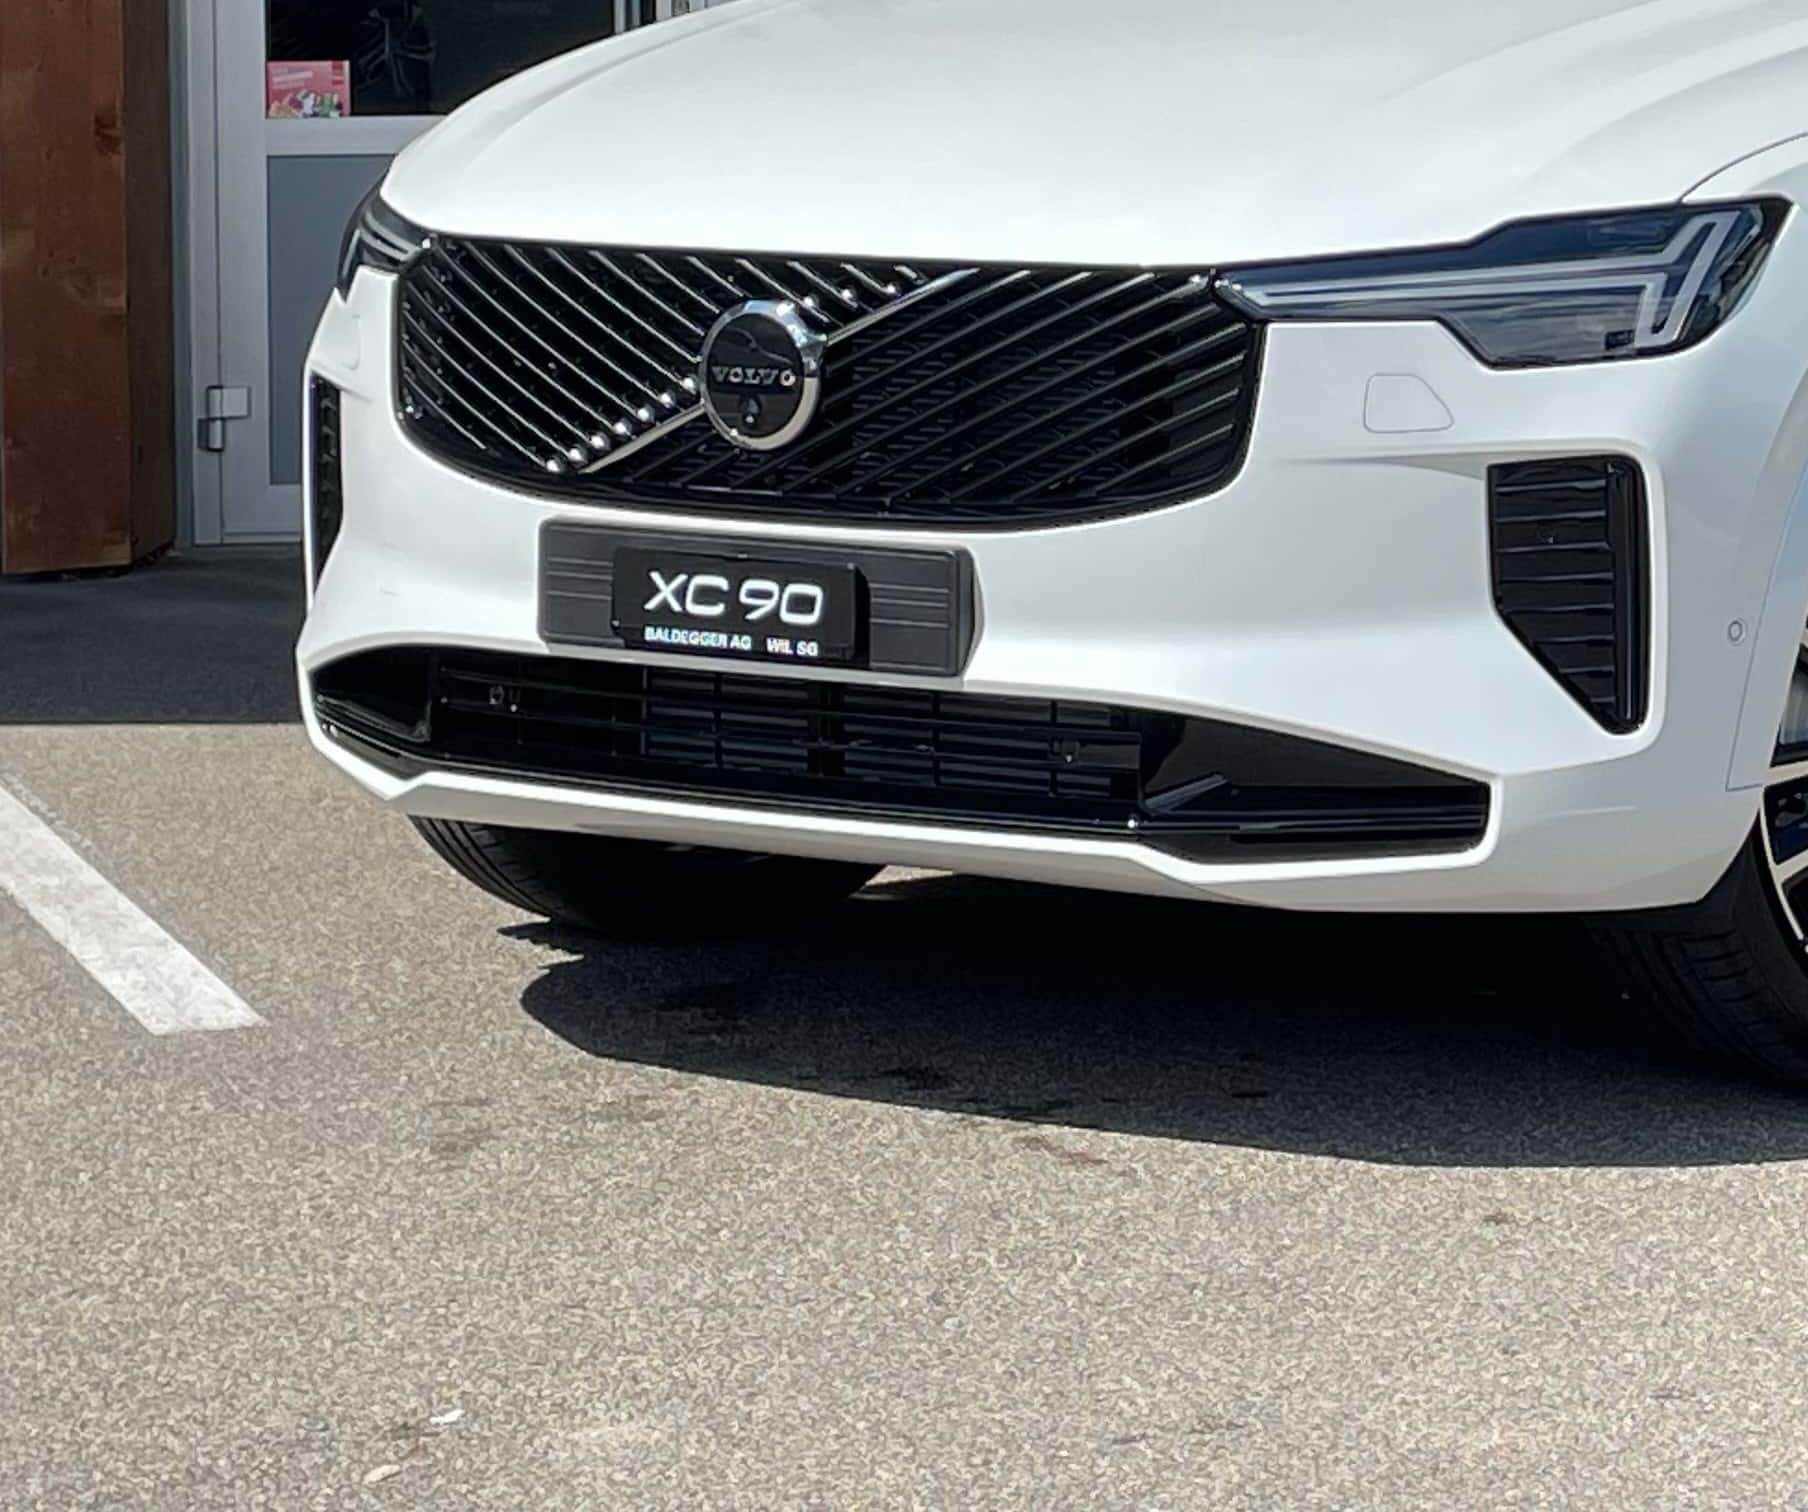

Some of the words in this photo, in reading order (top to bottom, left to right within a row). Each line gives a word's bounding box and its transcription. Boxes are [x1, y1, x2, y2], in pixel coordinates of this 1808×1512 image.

[711, 366, 796, 387] VOLVO
[643, 570, 730, 616] XC
[739, 578, 825, 626] 90
[643, 625, 728, 648] BALDEGGER
[765, 637, 793, 655] WIL
